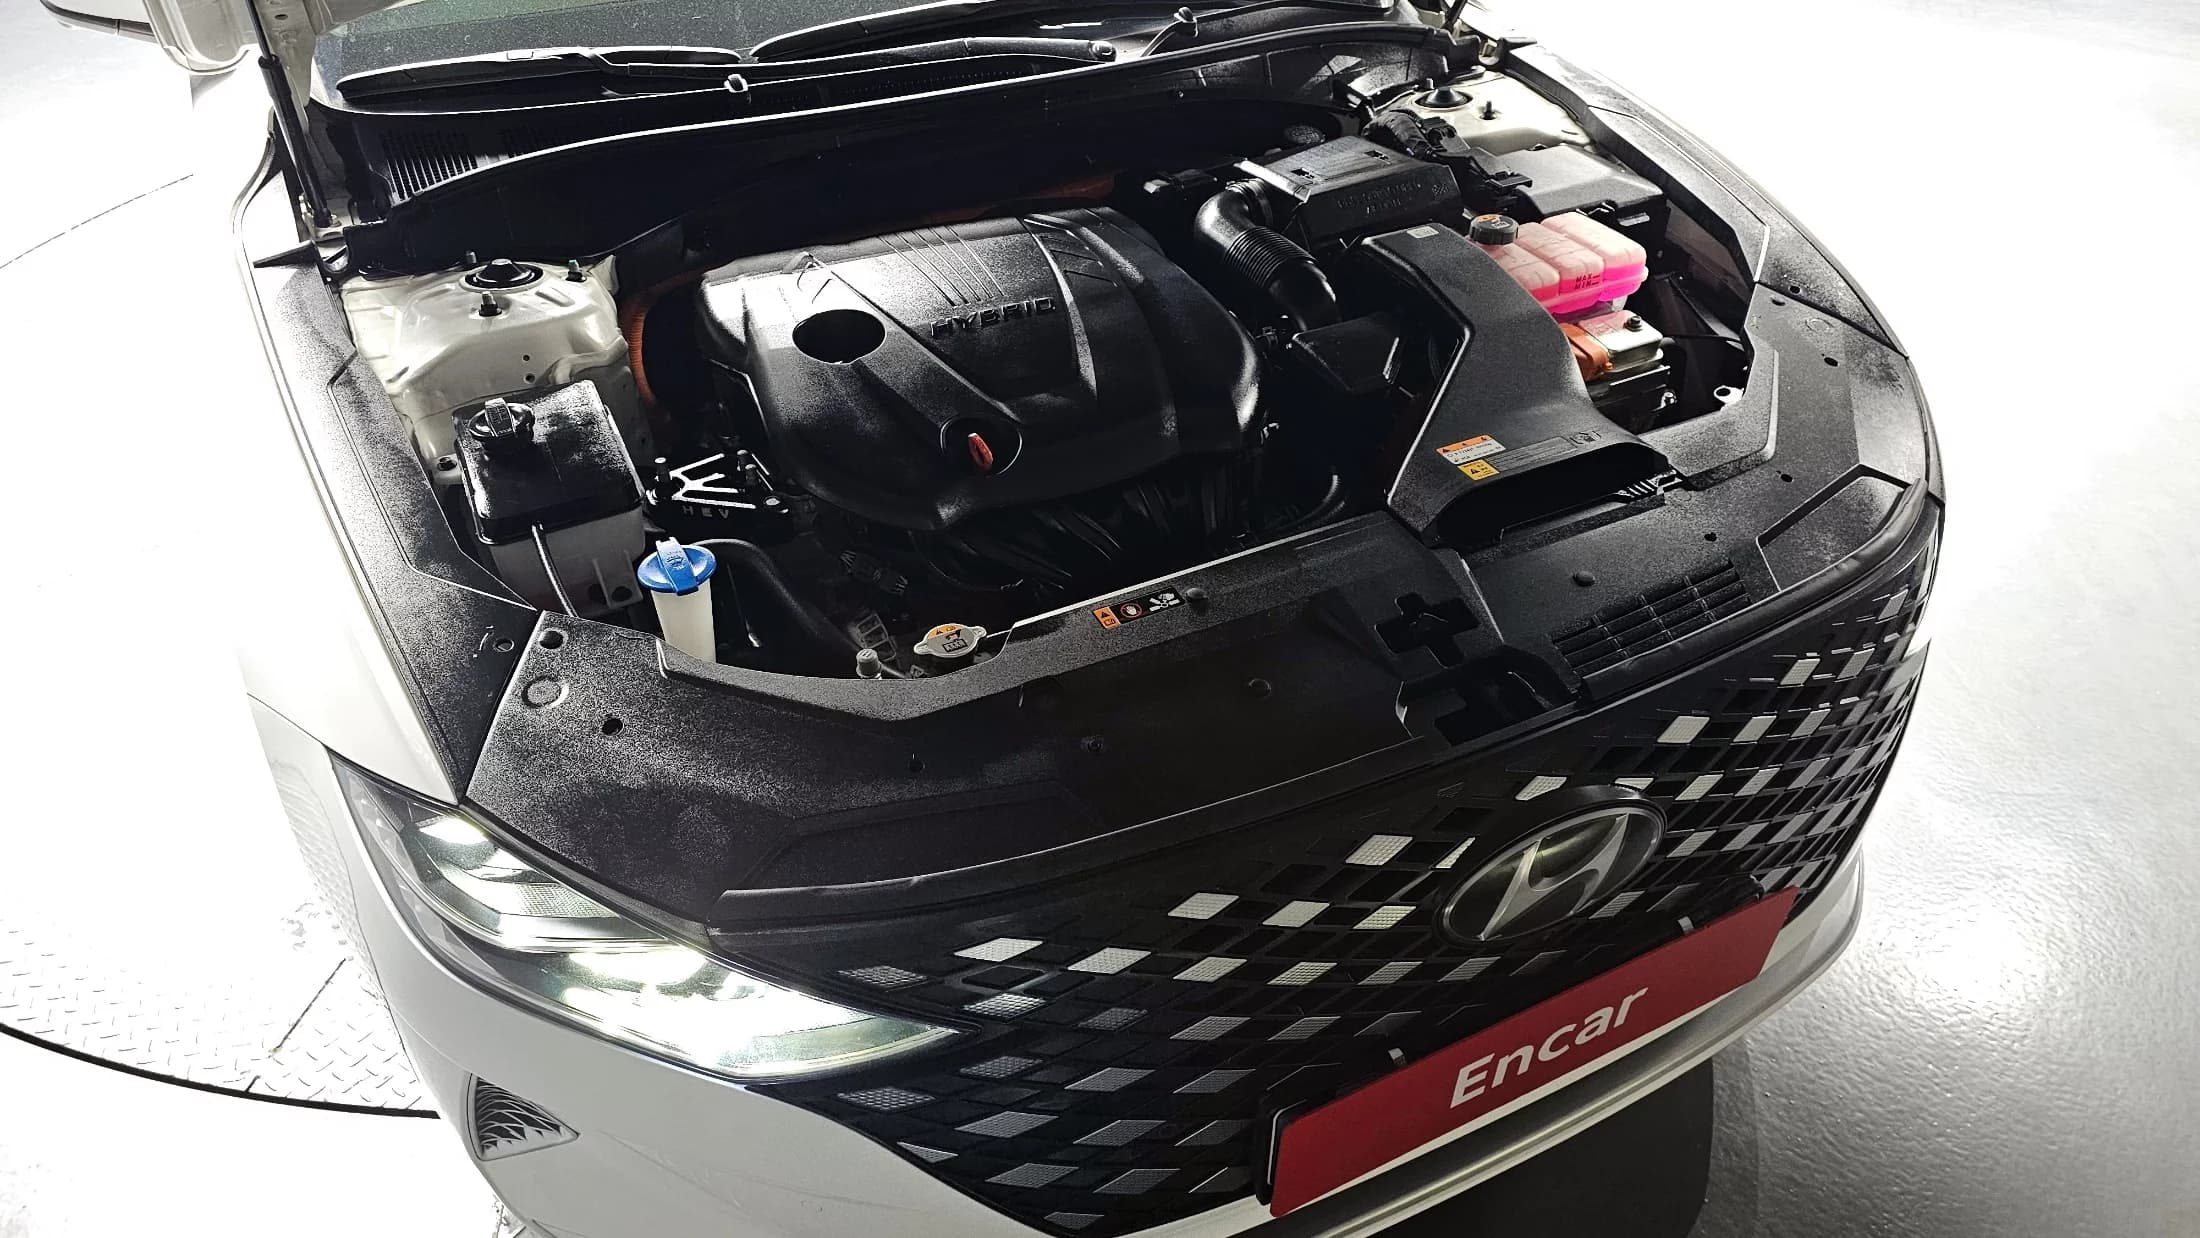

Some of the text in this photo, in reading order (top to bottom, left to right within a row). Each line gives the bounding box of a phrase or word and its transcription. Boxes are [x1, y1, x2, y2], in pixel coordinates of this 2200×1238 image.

[1575, 280, 1592, 290] MIN
[1576, 272, 1593, 283] MAX
[930, 297, 1055, 337] HYBRID
[1450, 987, 1648, 1109] Encar
